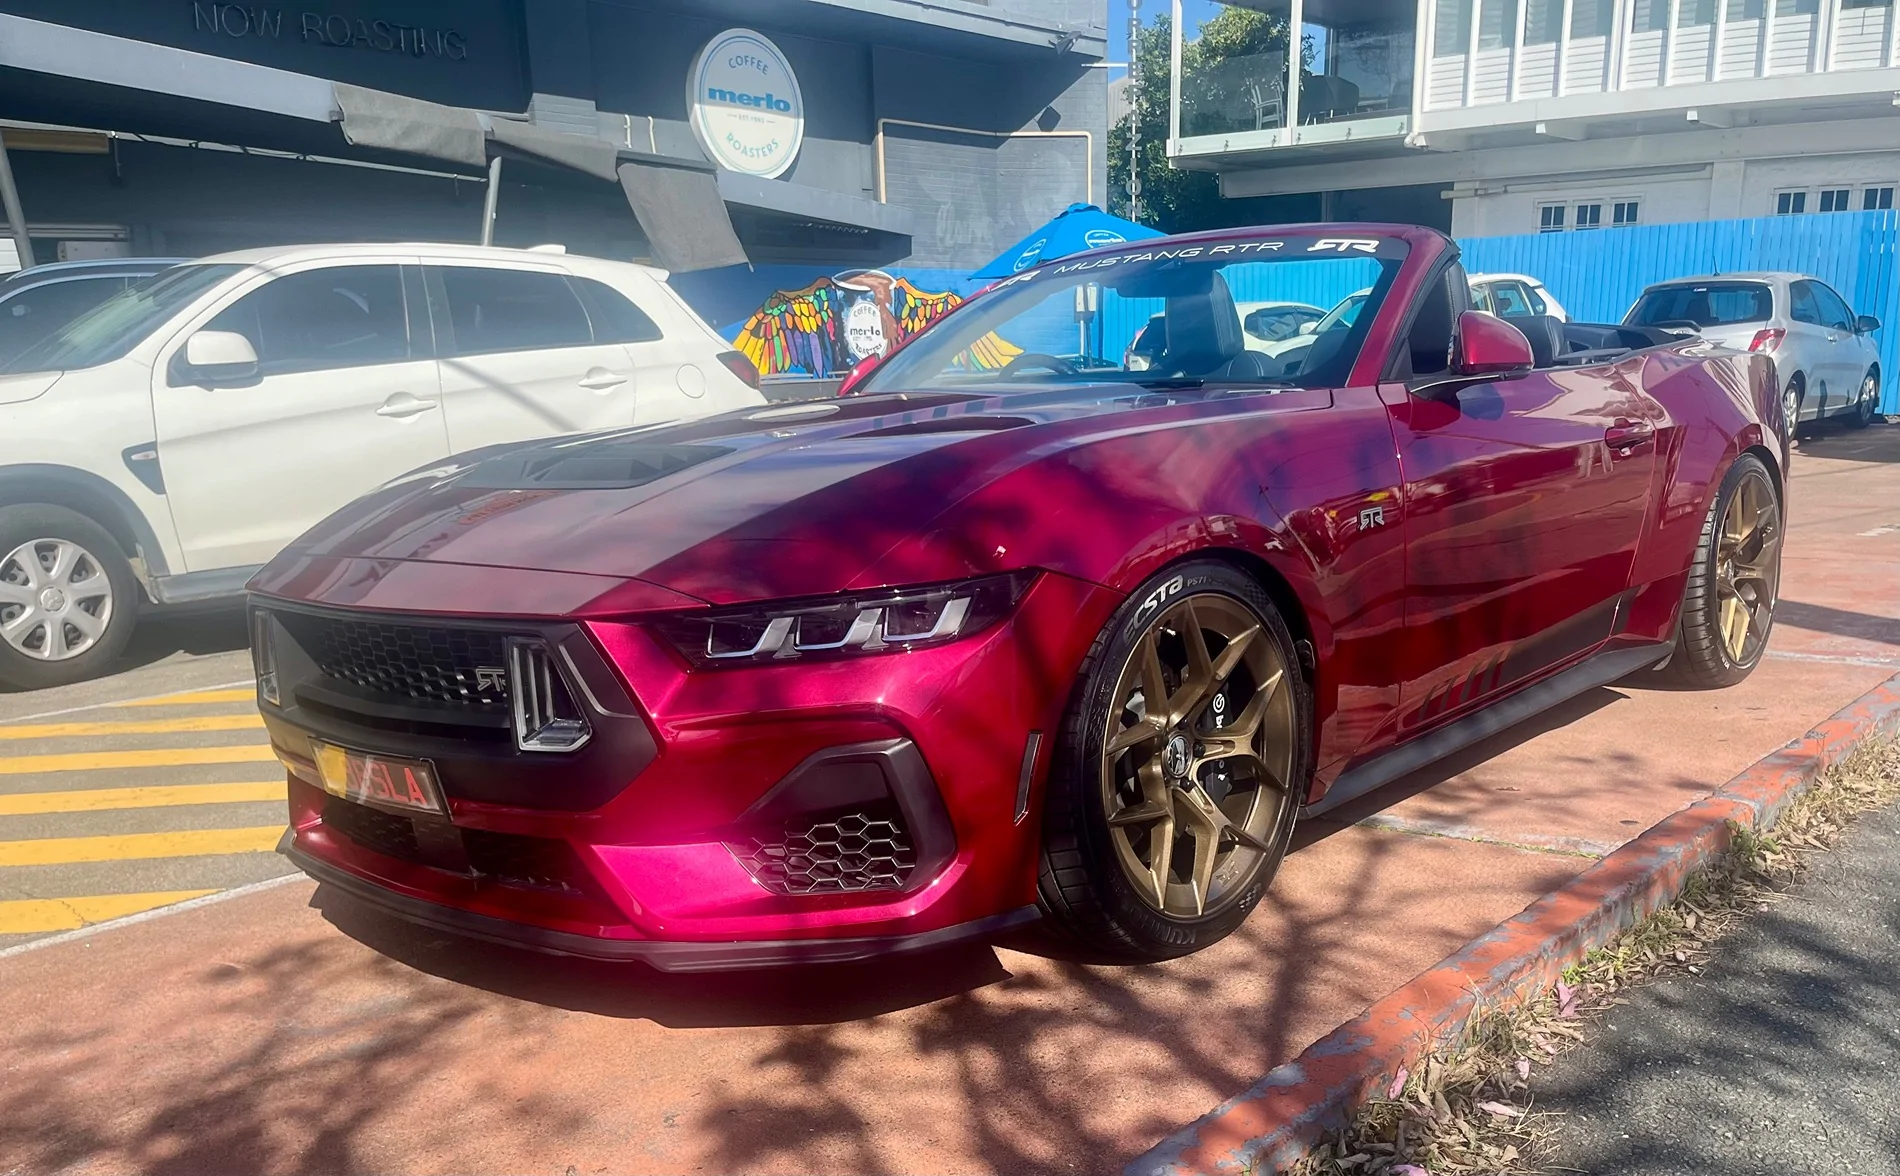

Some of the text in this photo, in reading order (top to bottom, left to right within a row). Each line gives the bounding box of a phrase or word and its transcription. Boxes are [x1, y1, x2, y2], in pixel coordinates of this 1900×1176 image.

[194, 1, 467, 60] NOW ROASTING
[728, 55, 769, 76] COFFEE
[708, 87, 791, 113] merlo
[726, 132, 780, 159] ROASTERS
[1053, 249, 1203, 275] MUSTANG
[1208, 241, 1284, 256] RTR
[853, 305, 877, 318] COFFEE
[850, 326, 881, 336] merlo
